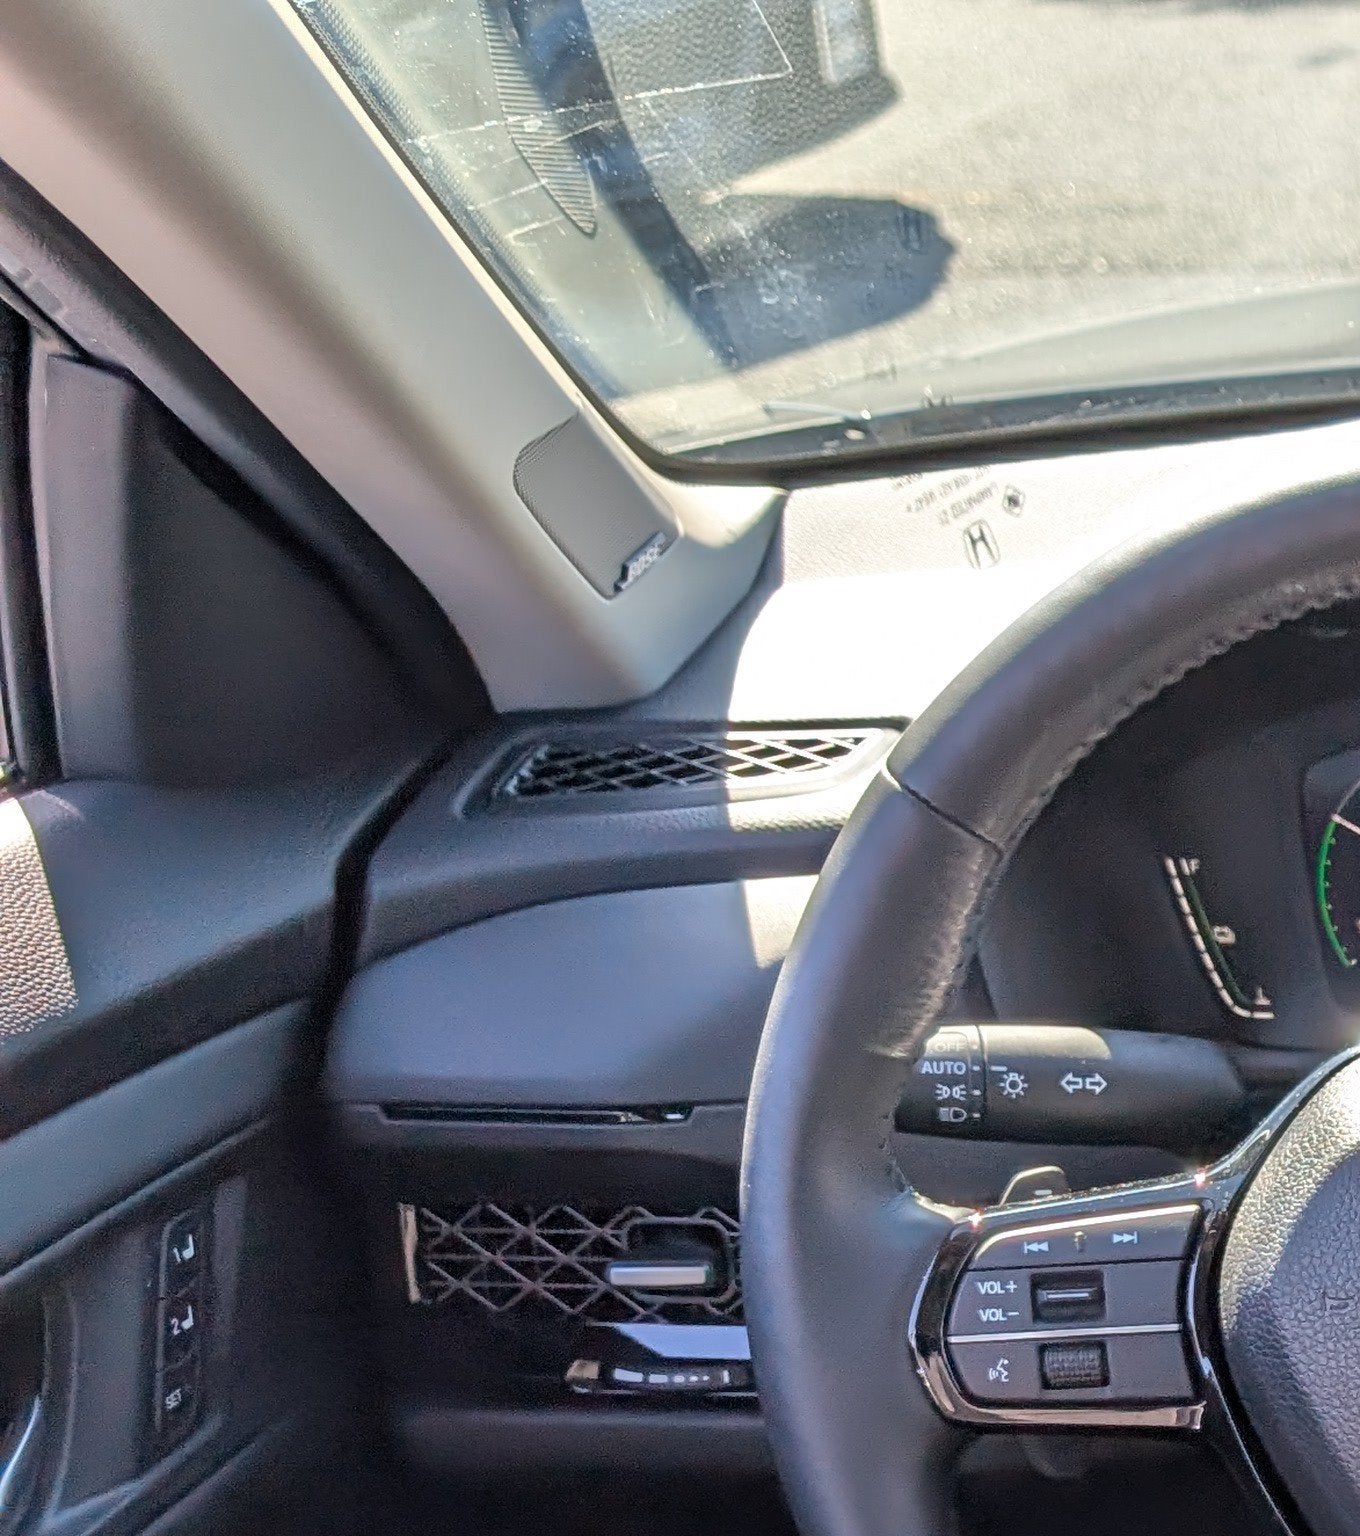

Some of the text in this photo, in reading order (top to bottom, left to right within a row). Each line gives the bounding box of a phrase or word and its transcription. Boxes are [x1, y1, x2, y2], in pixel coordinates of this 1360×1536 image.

[921, 1061, 967, 1075] AUTO
[172, 1247, 182, 1264] 1
[976, 1280, 1018, 1295] VOL+
[170, 1316, 181, 1336] 2
